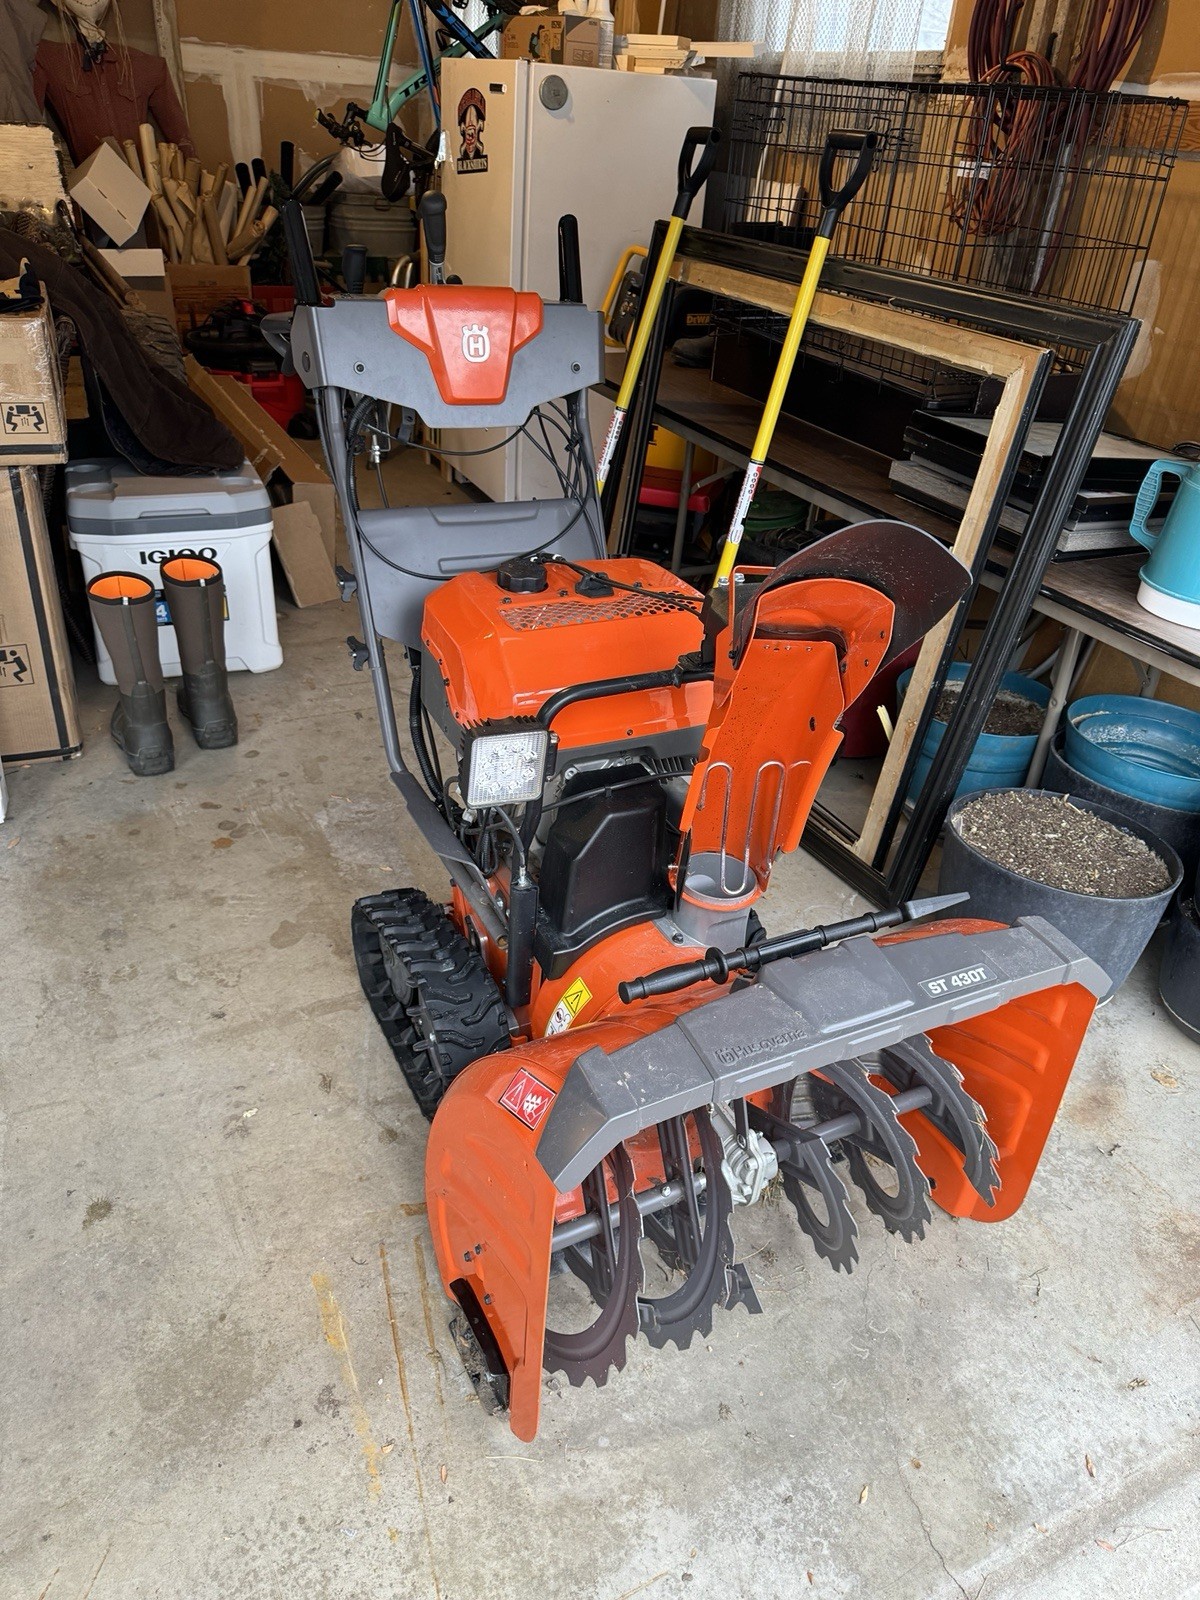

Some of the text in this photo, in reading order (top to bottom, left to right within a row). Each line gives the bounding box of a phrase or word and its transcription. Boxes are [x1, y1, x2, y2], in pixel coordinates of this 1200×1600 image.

[156, 604, 167, 616] 4
[928, 967, 988, 994] ST 430T
[731, 1029, 808, 1059] Husqvarna
